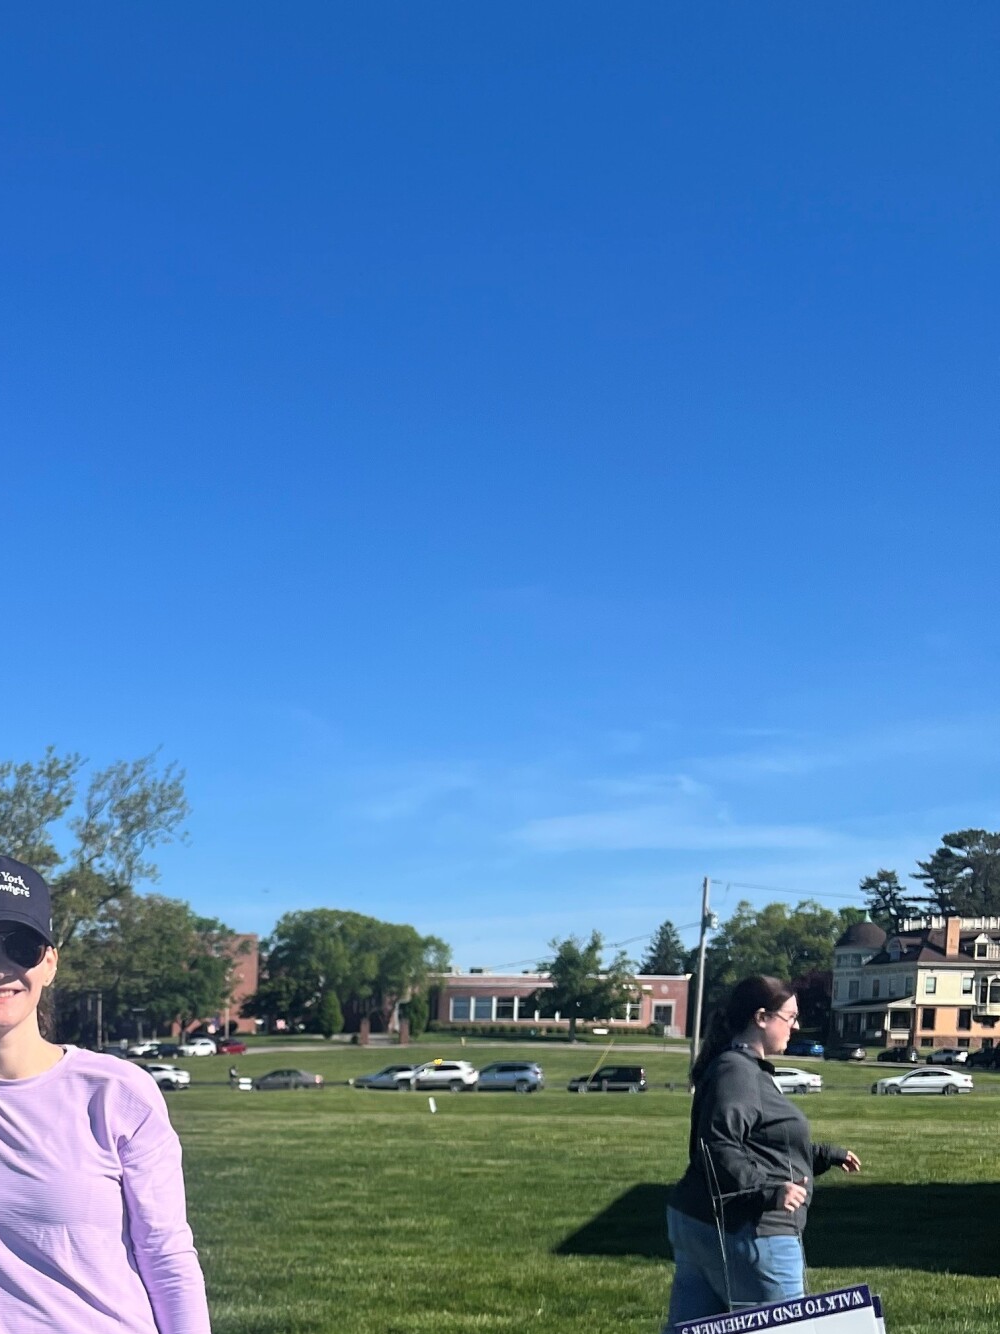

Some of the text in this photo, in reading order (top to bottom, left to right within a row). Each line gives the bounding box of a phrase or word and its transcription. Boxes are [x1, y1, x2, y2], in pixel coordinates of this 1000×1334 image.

[0, 871, 29, 890] York
[805, 1298, 825, 1315] TO
[827, 1290, 864, 1314] WALK
[773, 1302, 803, 1322] END
